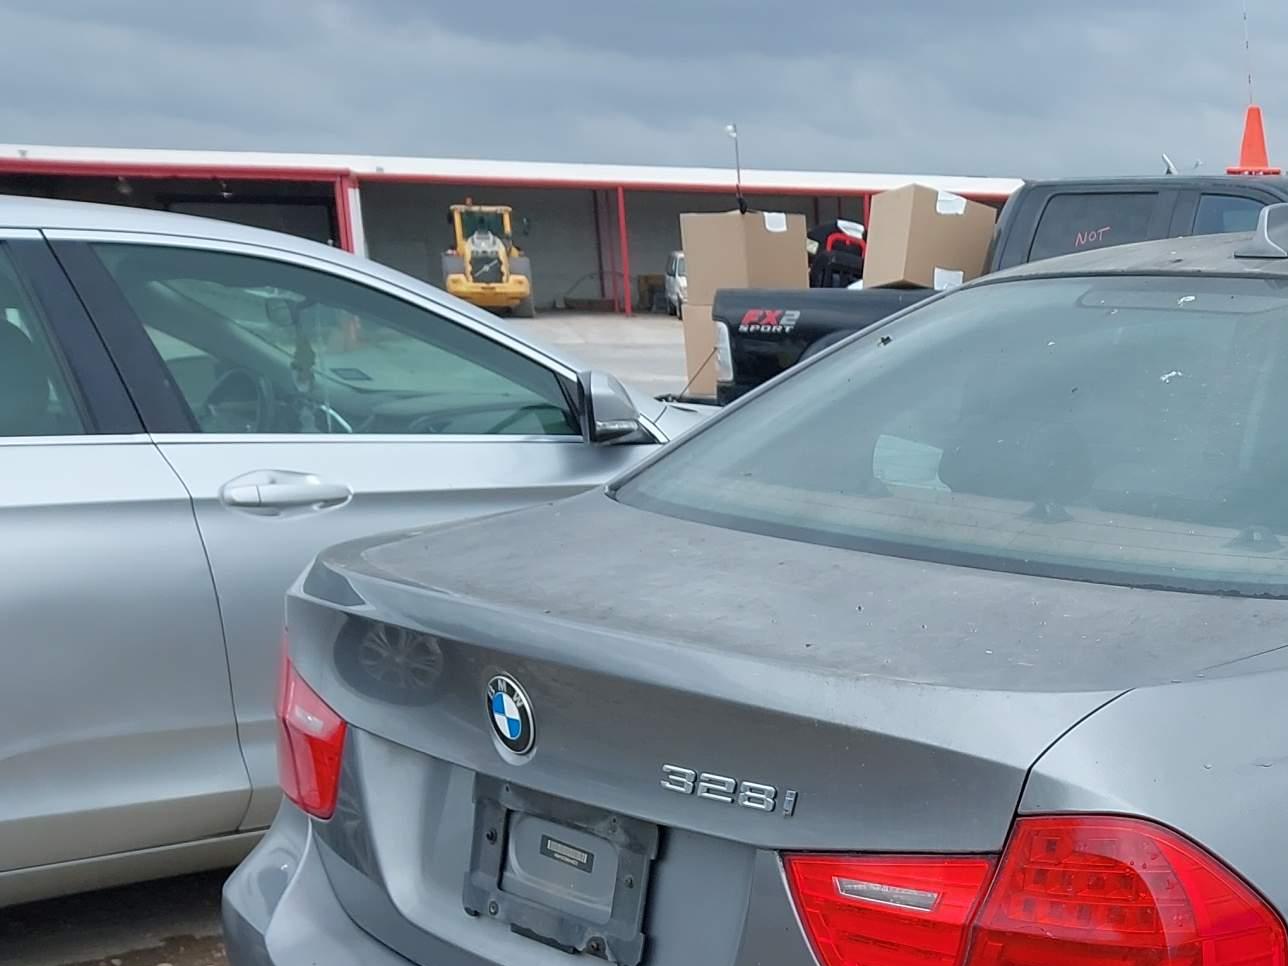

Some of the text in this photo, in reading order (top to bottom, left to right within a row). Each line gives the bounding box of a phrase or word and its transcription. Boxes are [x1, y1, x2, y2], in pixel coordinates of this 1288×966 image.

[1075, 226, 1111, 247] NOT
[740, 308, 801, 325] FX2
[738, 324, 794, 333] SPORT
[487, 679, 524, 708] BMW
[660, 763, 798, 817] 328i
